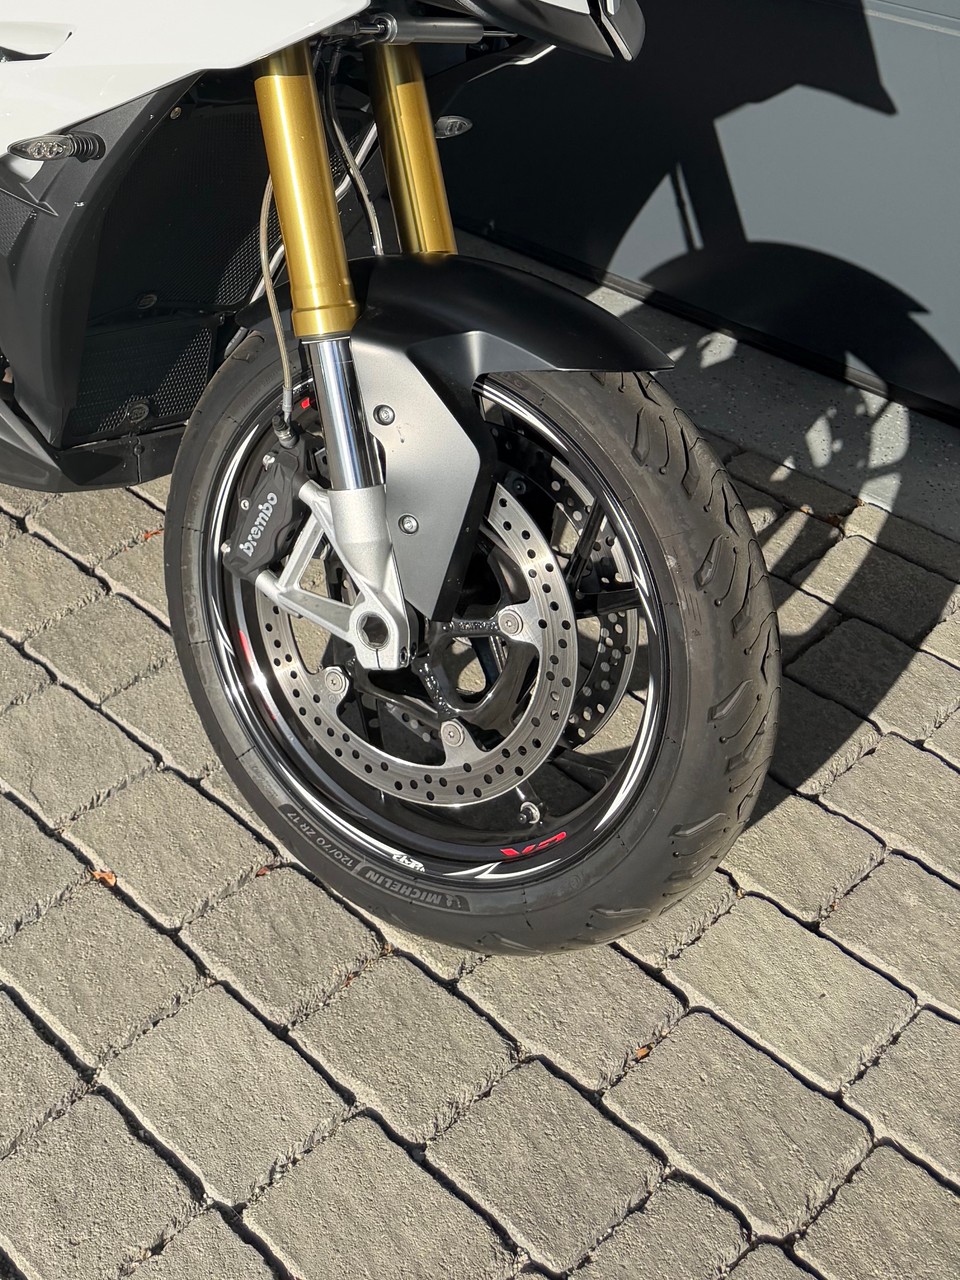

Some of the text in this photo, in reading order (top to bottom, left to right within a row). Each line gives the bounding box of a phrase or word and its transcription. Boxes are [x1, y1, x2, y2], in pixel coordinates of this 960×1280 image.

[239, 492, 278, 557] brembo
[287, 813, 353, 867] 120/70 ZR 17
[365, 870, 442, 904] MICHELIN
